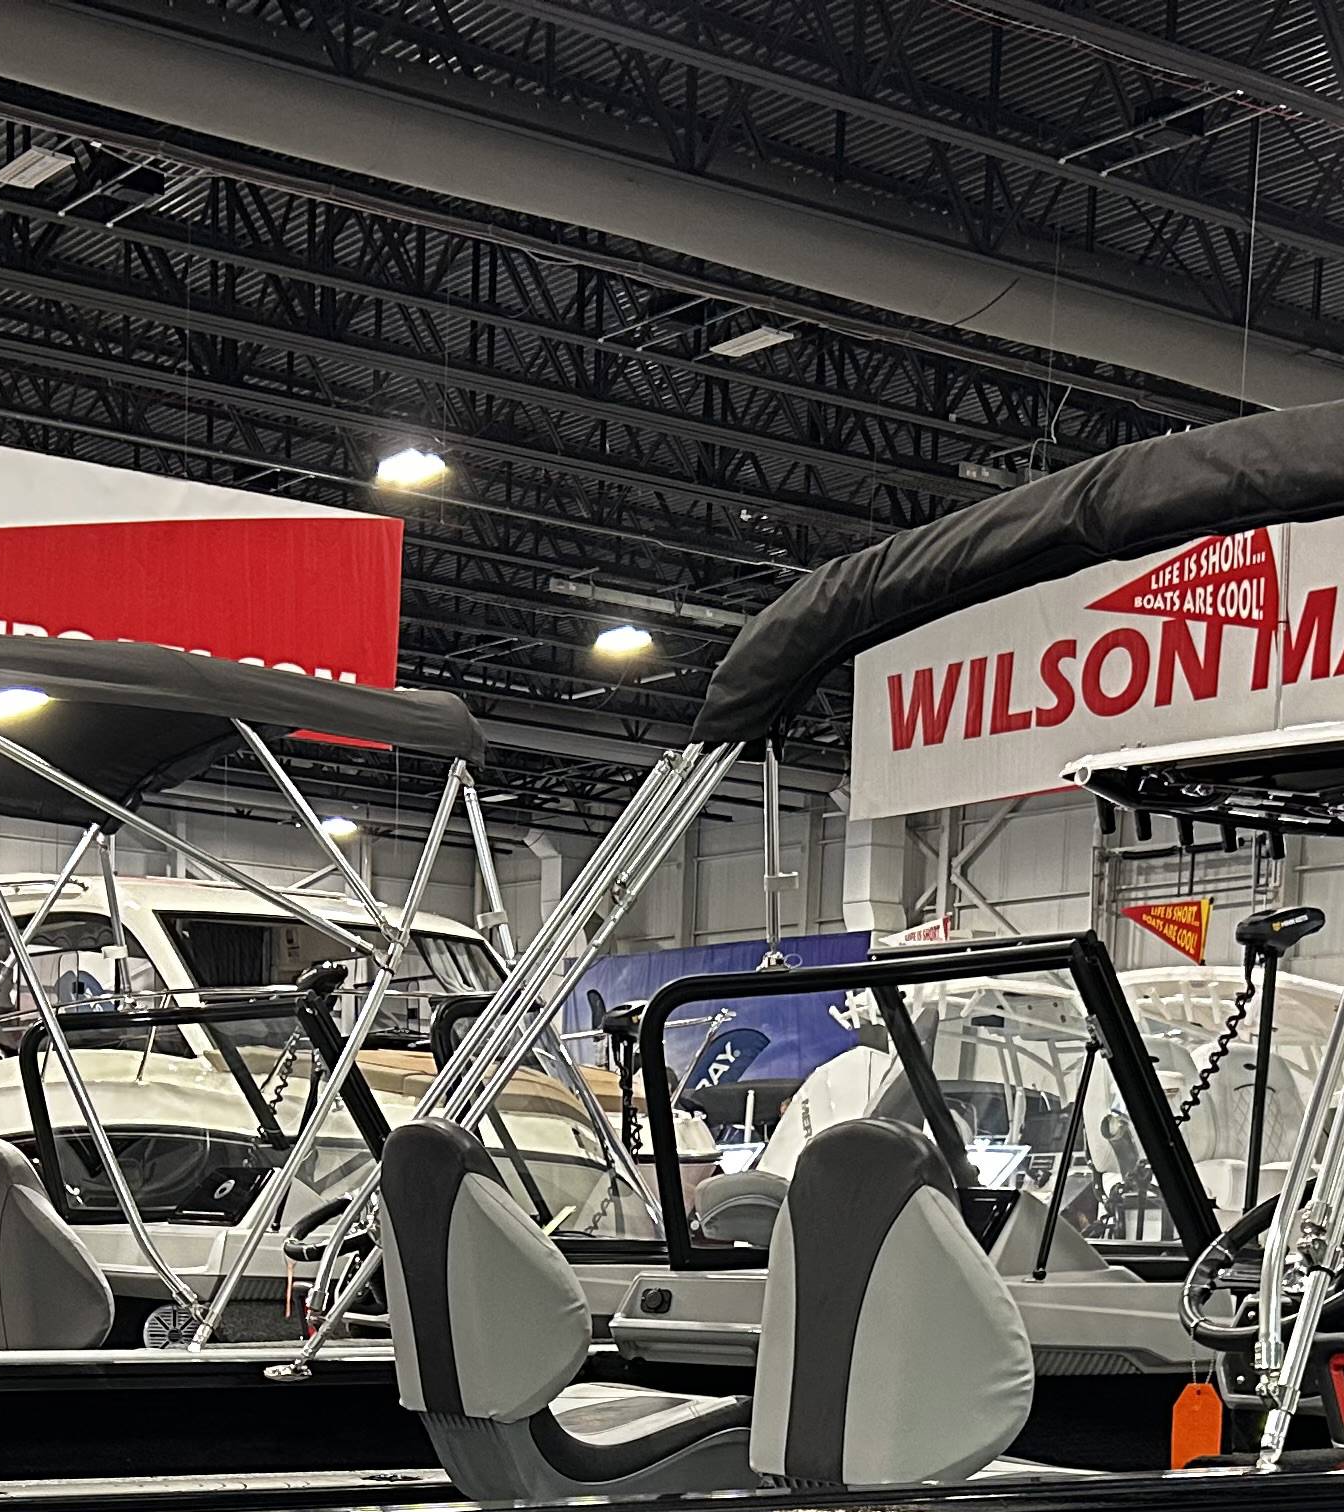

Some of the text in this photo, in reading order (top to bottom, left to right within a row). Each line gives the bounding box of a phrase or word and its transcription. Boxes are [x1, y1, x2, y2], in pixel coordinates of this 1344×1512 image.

[1150, 562, 1181, 590] LIFE
[1183, 552, 1197, 582] IS
[1133, 577, 1266, 621] BOATS ARE COOL!
[888, 616, 1221, 751] WILSON
